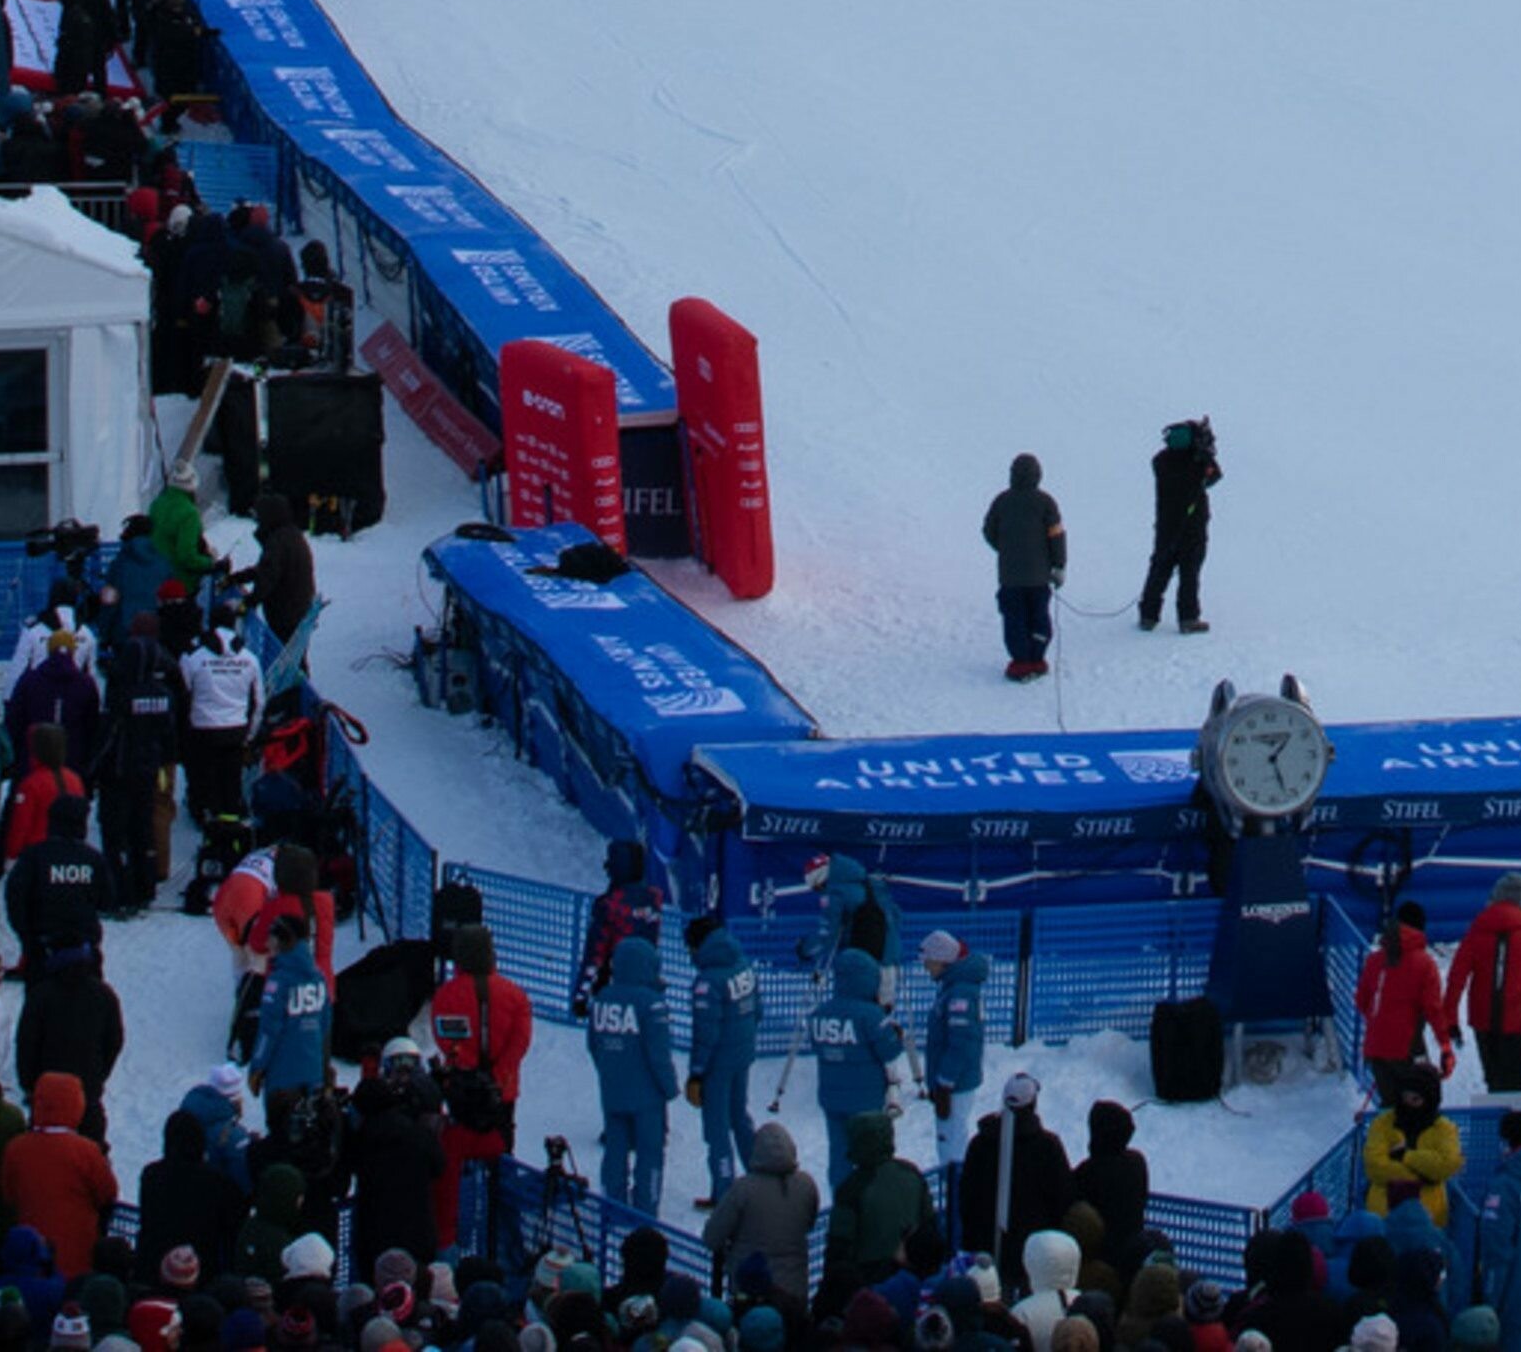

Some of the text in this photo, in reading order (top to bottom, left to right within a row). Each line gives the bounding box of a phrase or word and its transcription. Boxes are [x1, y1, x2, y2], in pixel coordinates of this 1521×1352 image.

[857, 751, 1091, 778] UNITED
[813, 767, 1106, 791] AIRLINES
[1382, 799, 1443, 820] STIFEL
[760, 813, 821, 836] STIFEL
[969, 817, 1030, 838] STIFEL
[1073, 816, 1136, 837] STIFEL
[51, 864, 94, 885] NOR
[1241, 901, 1311, 918] LONGINES
[593, 1001, 640, 1036] USA
[812, 1017, 858, 1045] USA
